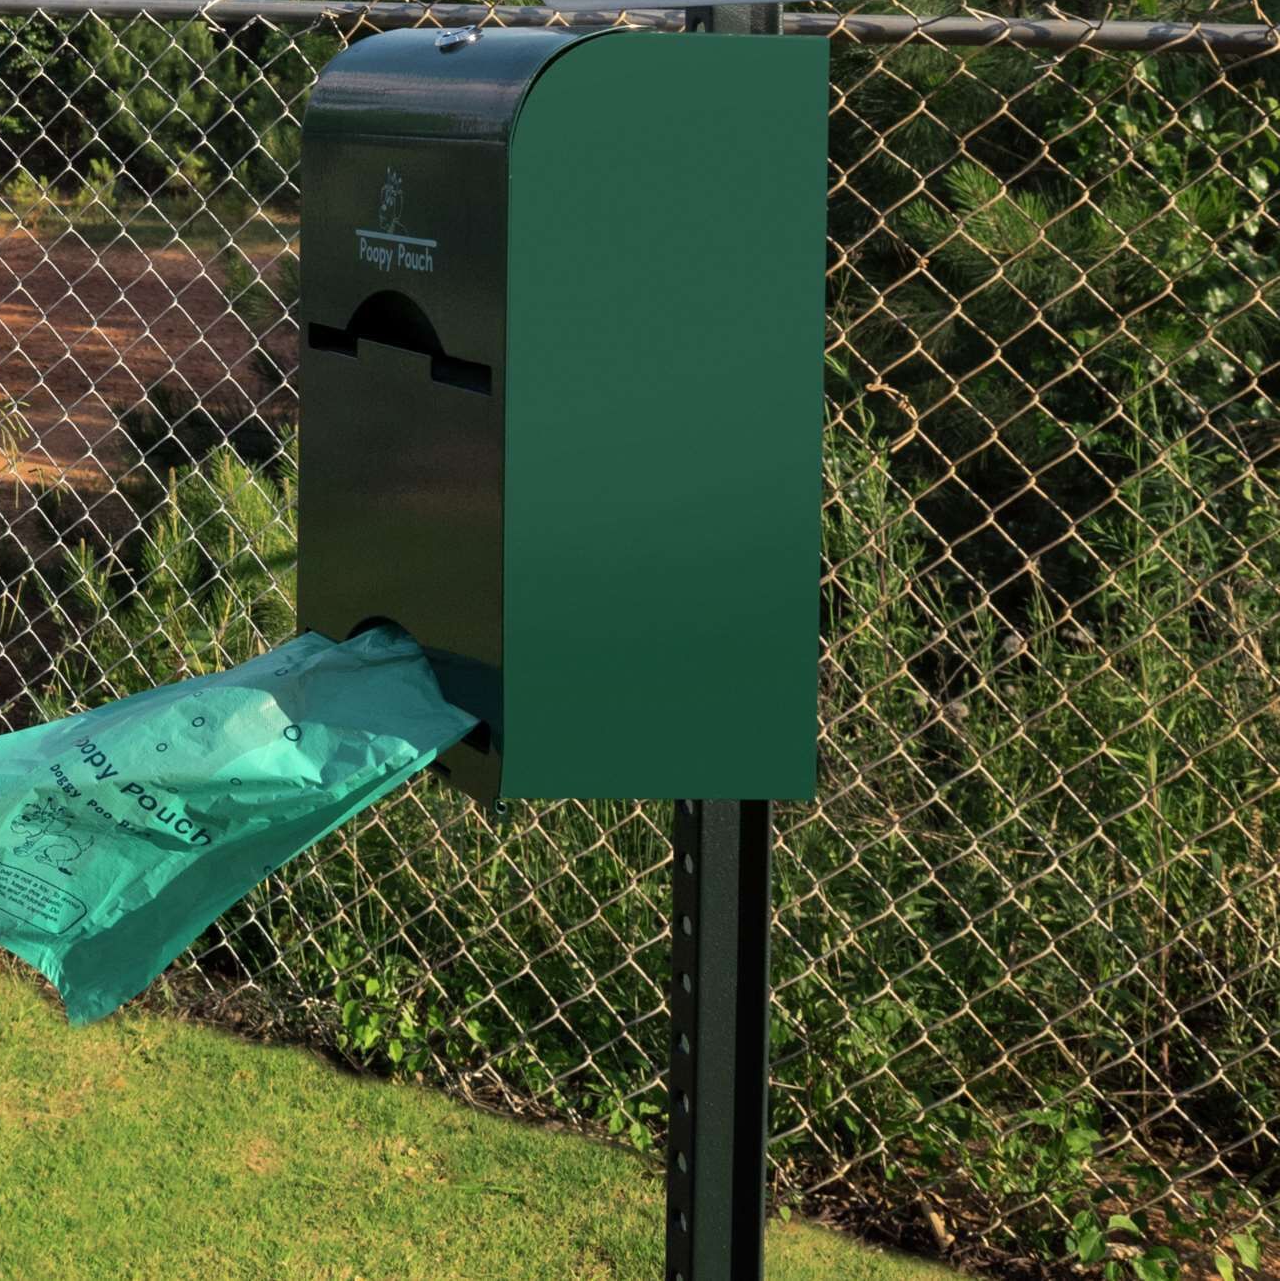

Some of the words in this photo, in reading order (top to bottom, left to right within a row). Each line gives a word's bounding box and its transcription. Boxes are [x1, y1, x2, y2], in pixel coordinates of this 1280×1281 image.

[359, 237, 393, 272] Poopy
[397, 243, 434, 272] Pouch
[49, 763, 82, 798] Doggy
[86, 799, 113, 820] Poo
[73, 735, 119, 781] oopy
[120, 781, 212, 847] Pouch
